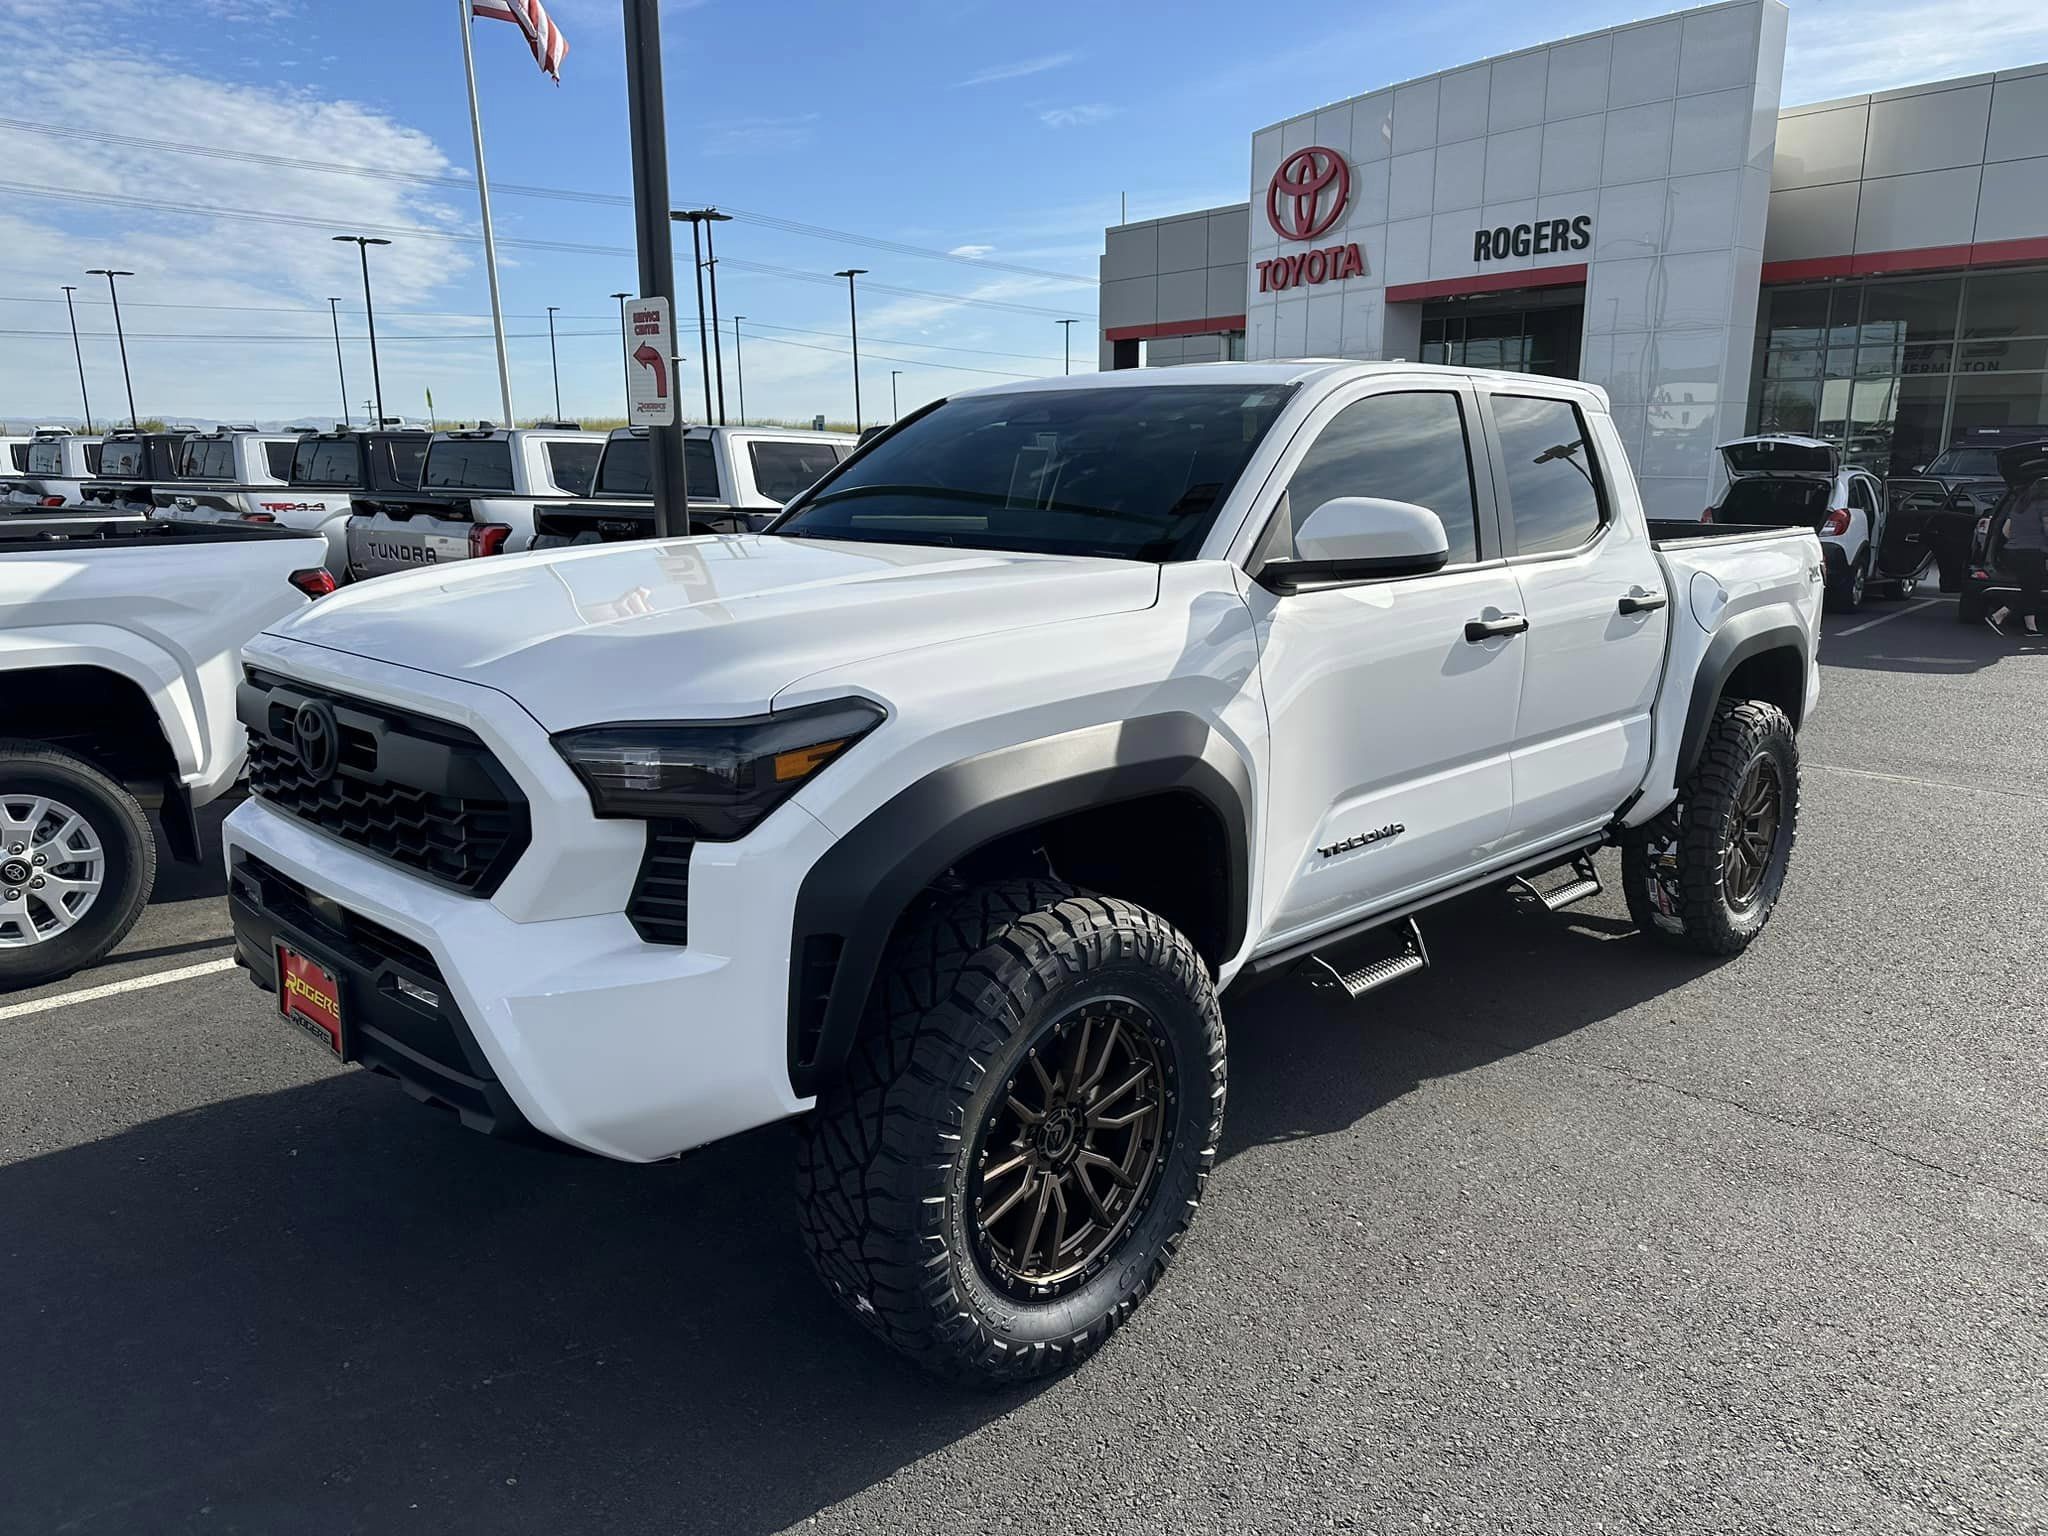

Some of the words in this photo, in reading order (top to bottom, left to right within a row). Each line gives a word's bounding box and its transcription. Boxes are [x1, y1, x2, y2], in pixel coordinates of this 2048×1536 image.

[1474, 215, 1591, 262] ROGERS
[1256, 243, 1365, 292] TOYOTA
[368, 543, 438, 564] TUNDRA
[1317, 823, 1405, 858] TACOMA
[284, 969, 340, 1019] ROGERS
